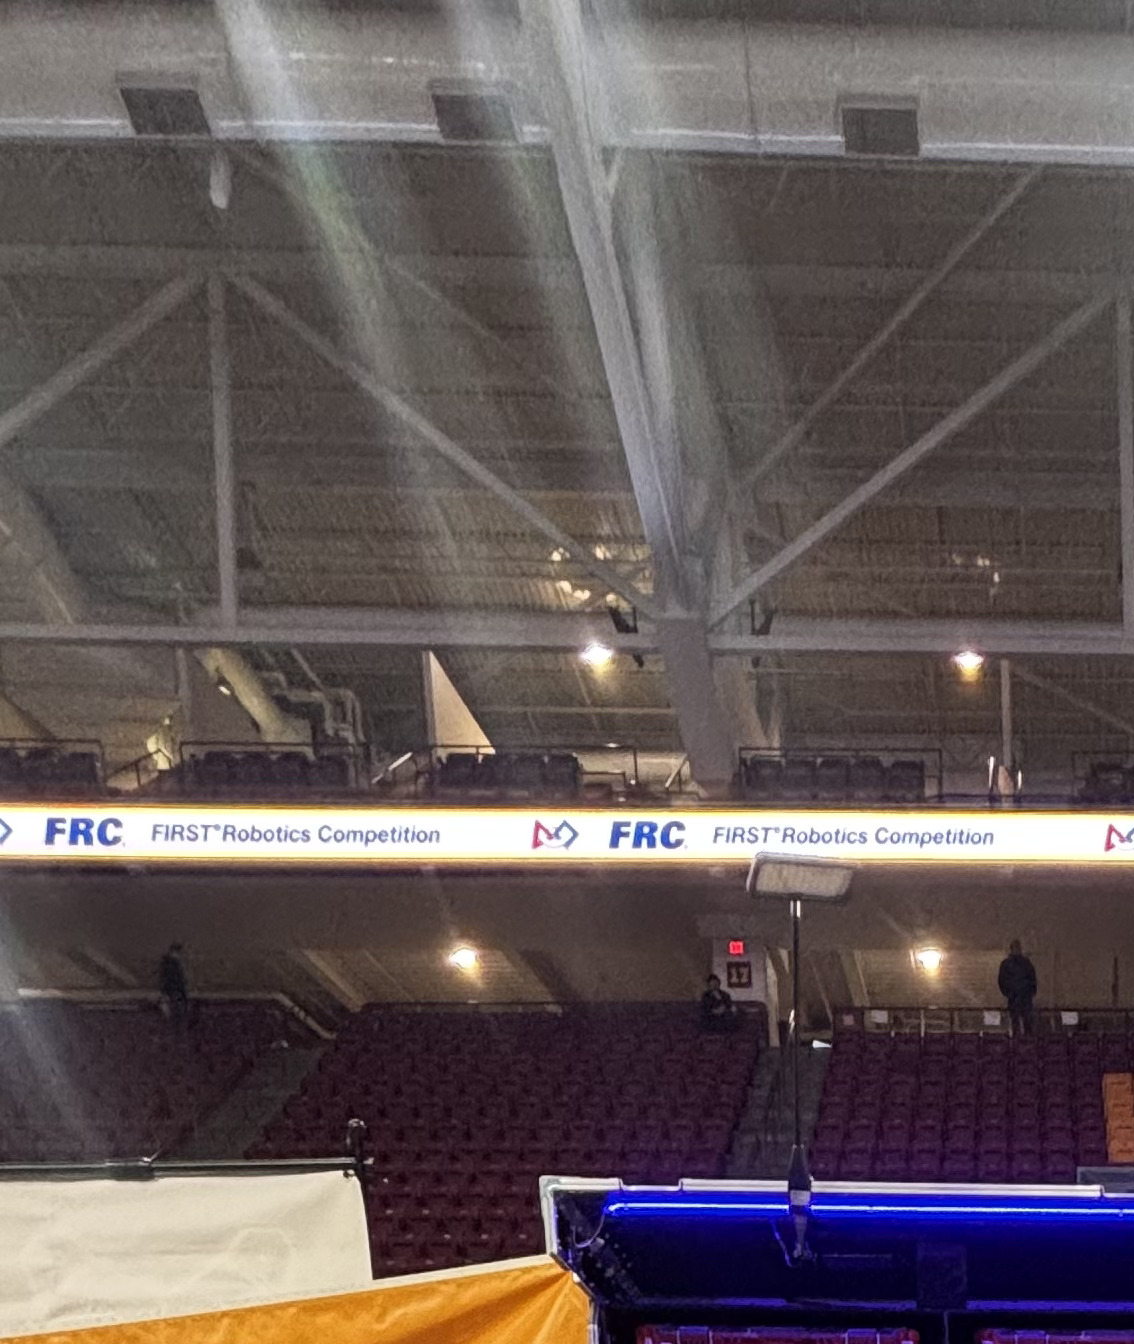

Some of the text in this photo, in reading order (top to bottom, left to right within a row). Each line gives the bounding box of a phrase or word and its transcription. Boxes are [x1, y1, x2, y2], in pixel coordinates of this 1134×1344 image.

[45, 817, 124, 846] FRC
[222, 824, 311, 843] Robotics
[317, 825, 441, 847] Competition
[609, 821, 687, 849] FRC
[781, 827, 868, 845] Robotics
[875, 827, 994, 848] Competition
